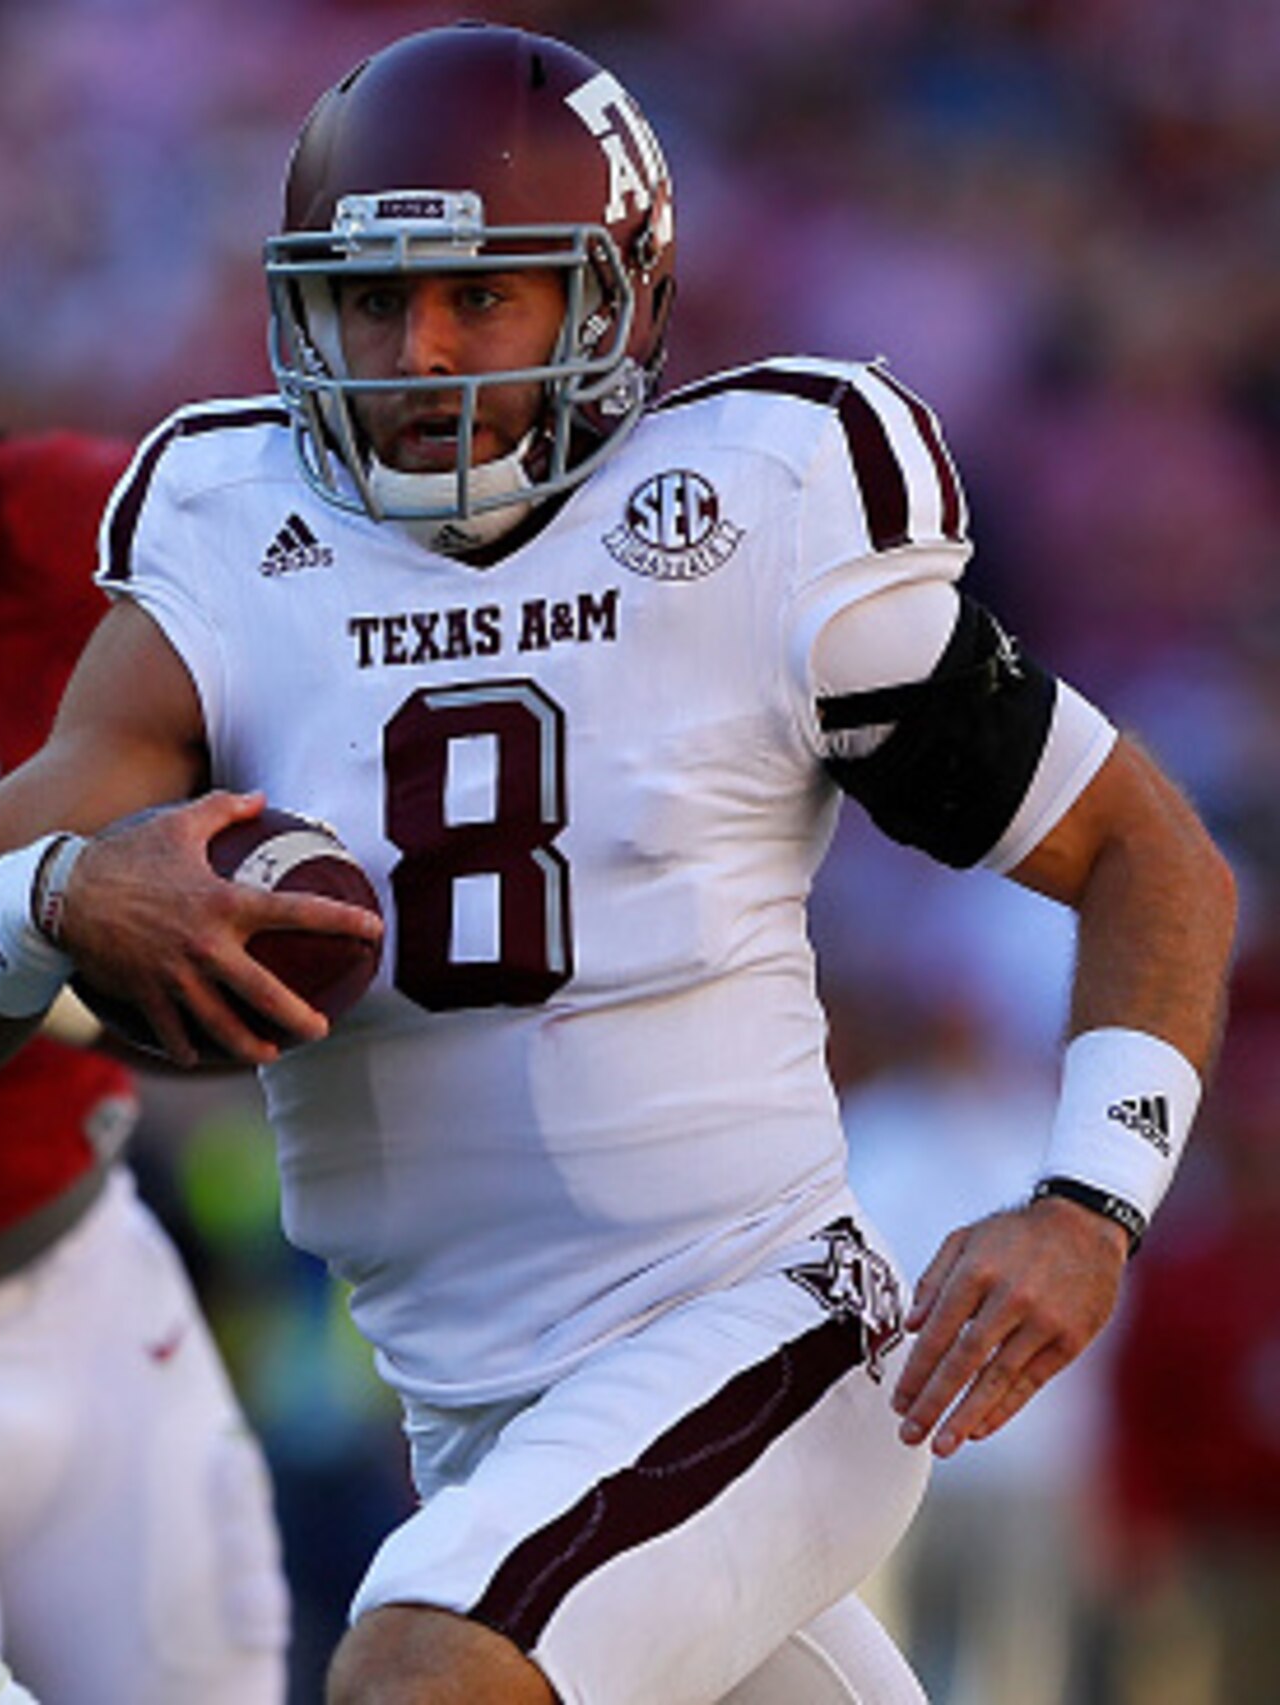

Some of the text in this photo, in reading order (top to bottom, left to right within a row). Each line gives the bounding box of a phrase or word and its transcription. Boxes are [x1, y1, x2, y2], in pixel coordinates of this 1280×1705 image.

[631, 473, 713, 549] SEC
[347, 587, 621, 669] TEXAS A&M
[383, 677, 576, 1013] 8
